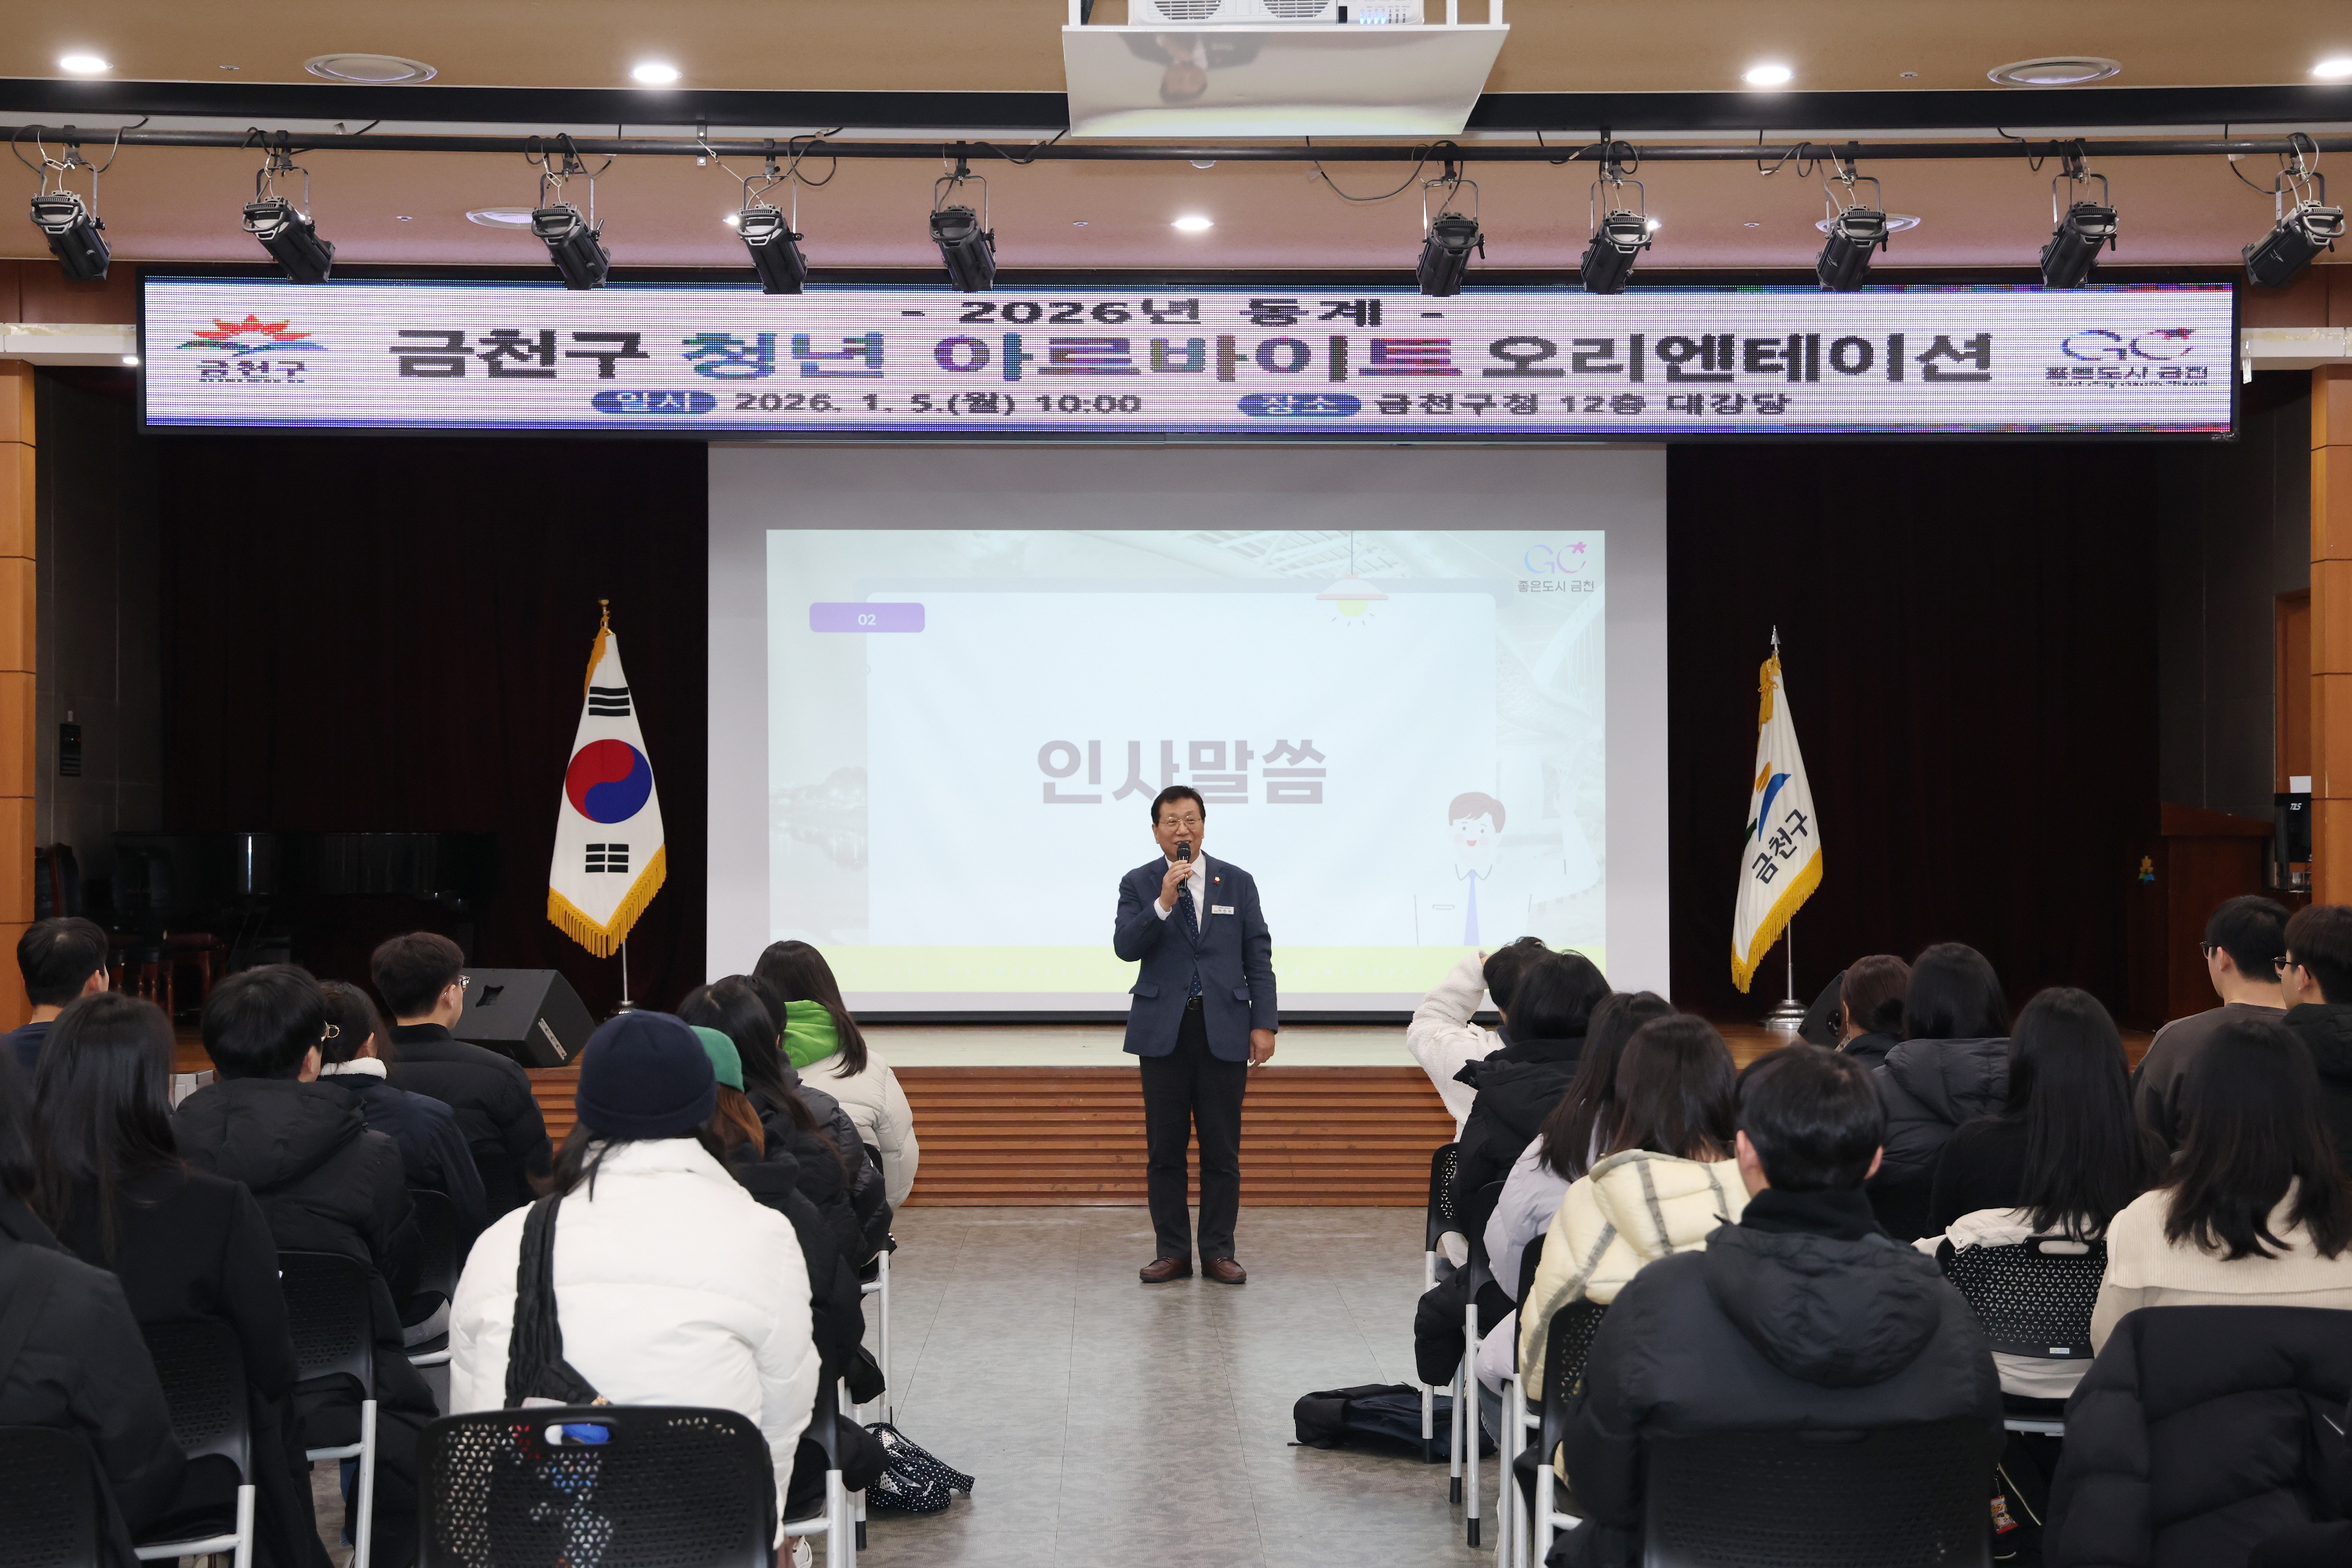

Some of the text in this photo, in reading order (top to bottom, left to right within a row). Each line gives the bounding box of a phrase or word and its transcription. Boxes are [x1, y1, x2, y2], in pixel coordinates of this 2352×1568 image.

[958, 299, 1201, 325] 2026년
[1240, 299, 1383, 327] 동계
[390, 329, 1993, 383] 금천구 청년 아르바이트 오리엔테이션
[196, 360, 310, 379] 금천구
[616, 392, 1142, 416] 일시 2026. 1. 5.(월) 10:00
[1375, 394, 1539, 417] 금천구청
[1559, 394, 1646, 415] 12층
[1666, 393, 1792, 416] 대강당
[1518, 580, 1595, 593] 좋은도시 금천
[858, 613, 877, 626] 02
[1037, 739, 1327, 804] 인사말씀
[1751, 808, 1808, 884] 금천구
